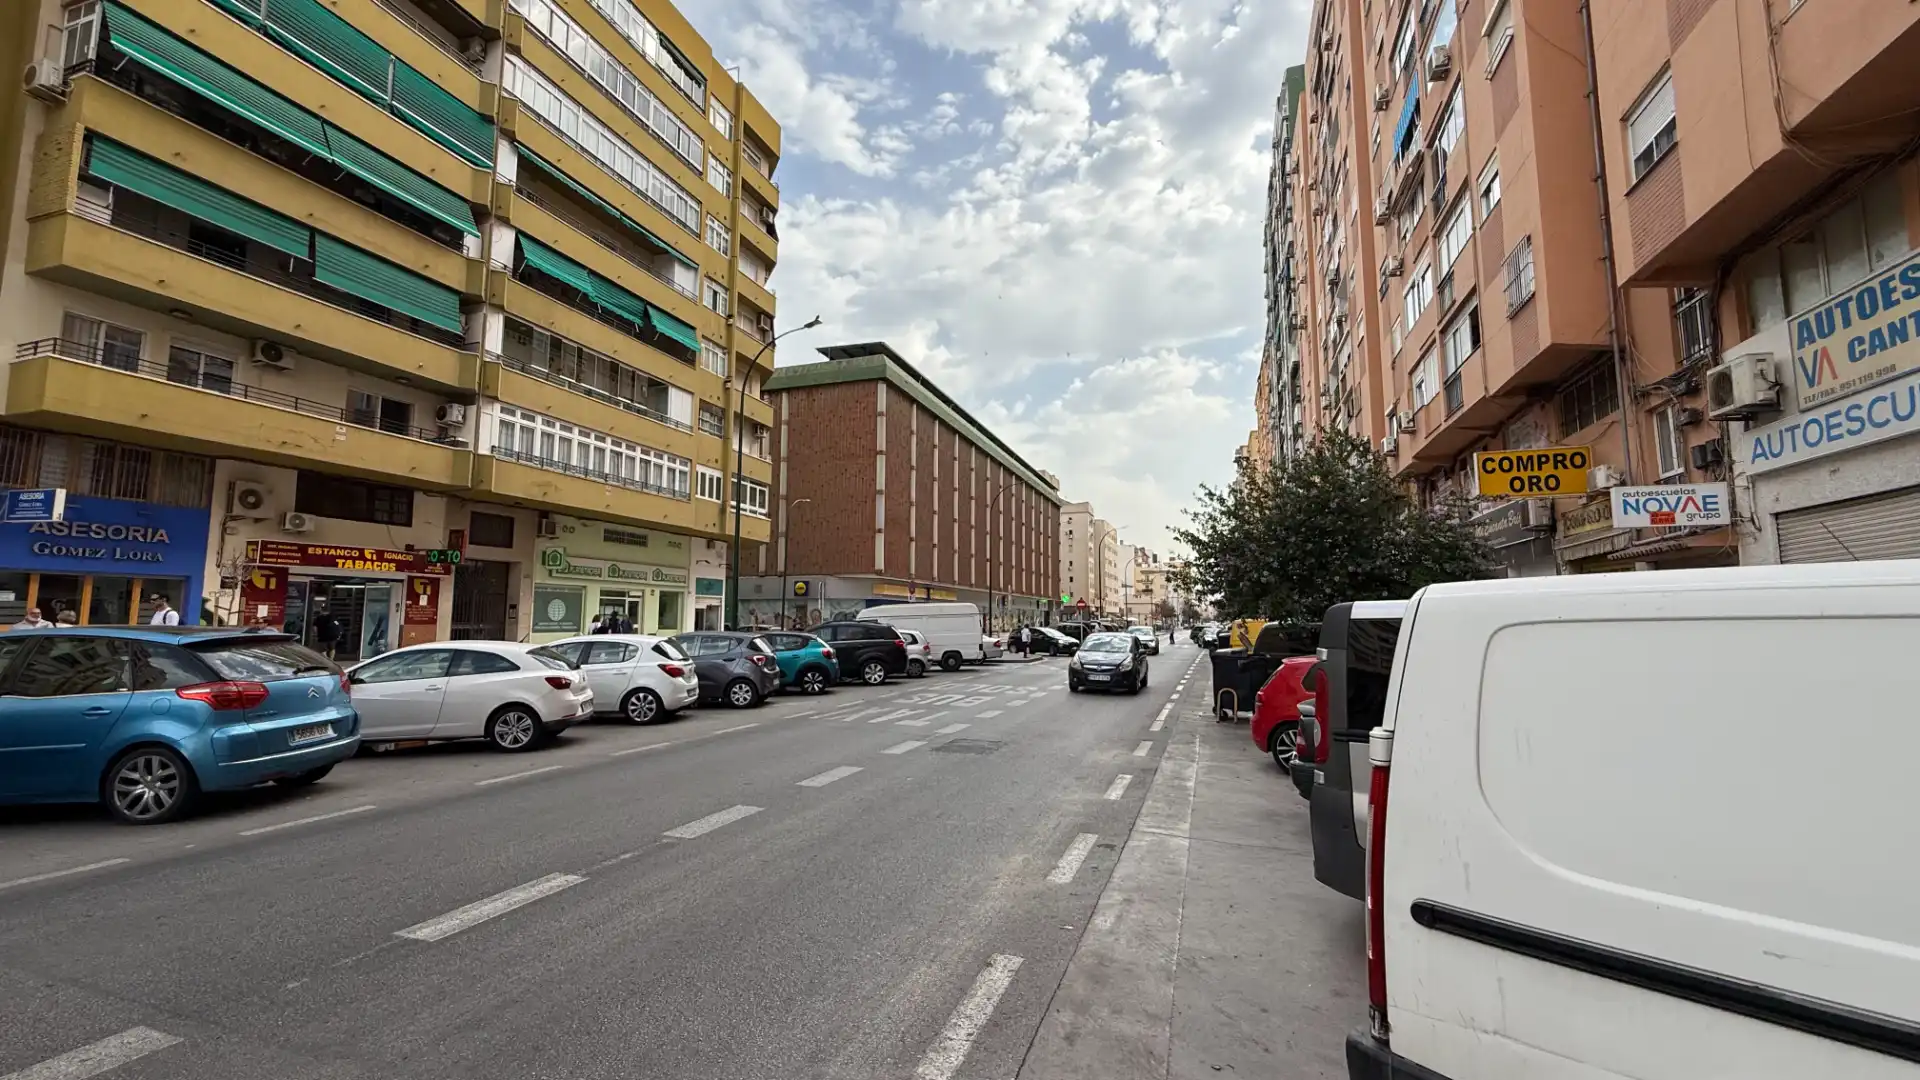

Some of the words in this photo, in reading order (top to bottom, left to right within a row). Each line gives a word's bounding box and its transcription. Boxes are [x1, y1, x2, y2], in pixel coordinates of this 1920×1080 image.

[1751, 383, 1920, 465] AUTOESCU
[1482, 451, 1587, 474] COMPRO
[1509, 474, 1561, 493] ORO
[1622, 488, 1696, 498] autoescuelas
[1622, 494, 1720, 515] NOVAE
[1686, 512, 1721, 521] grupo
[28, 520, 170, 544] ASESORIA
[308, 547, 359, 557] ESTANCO
[384, 551, 413, 561] IGNACIO
[336, 558, 396, 572] TABACOS
